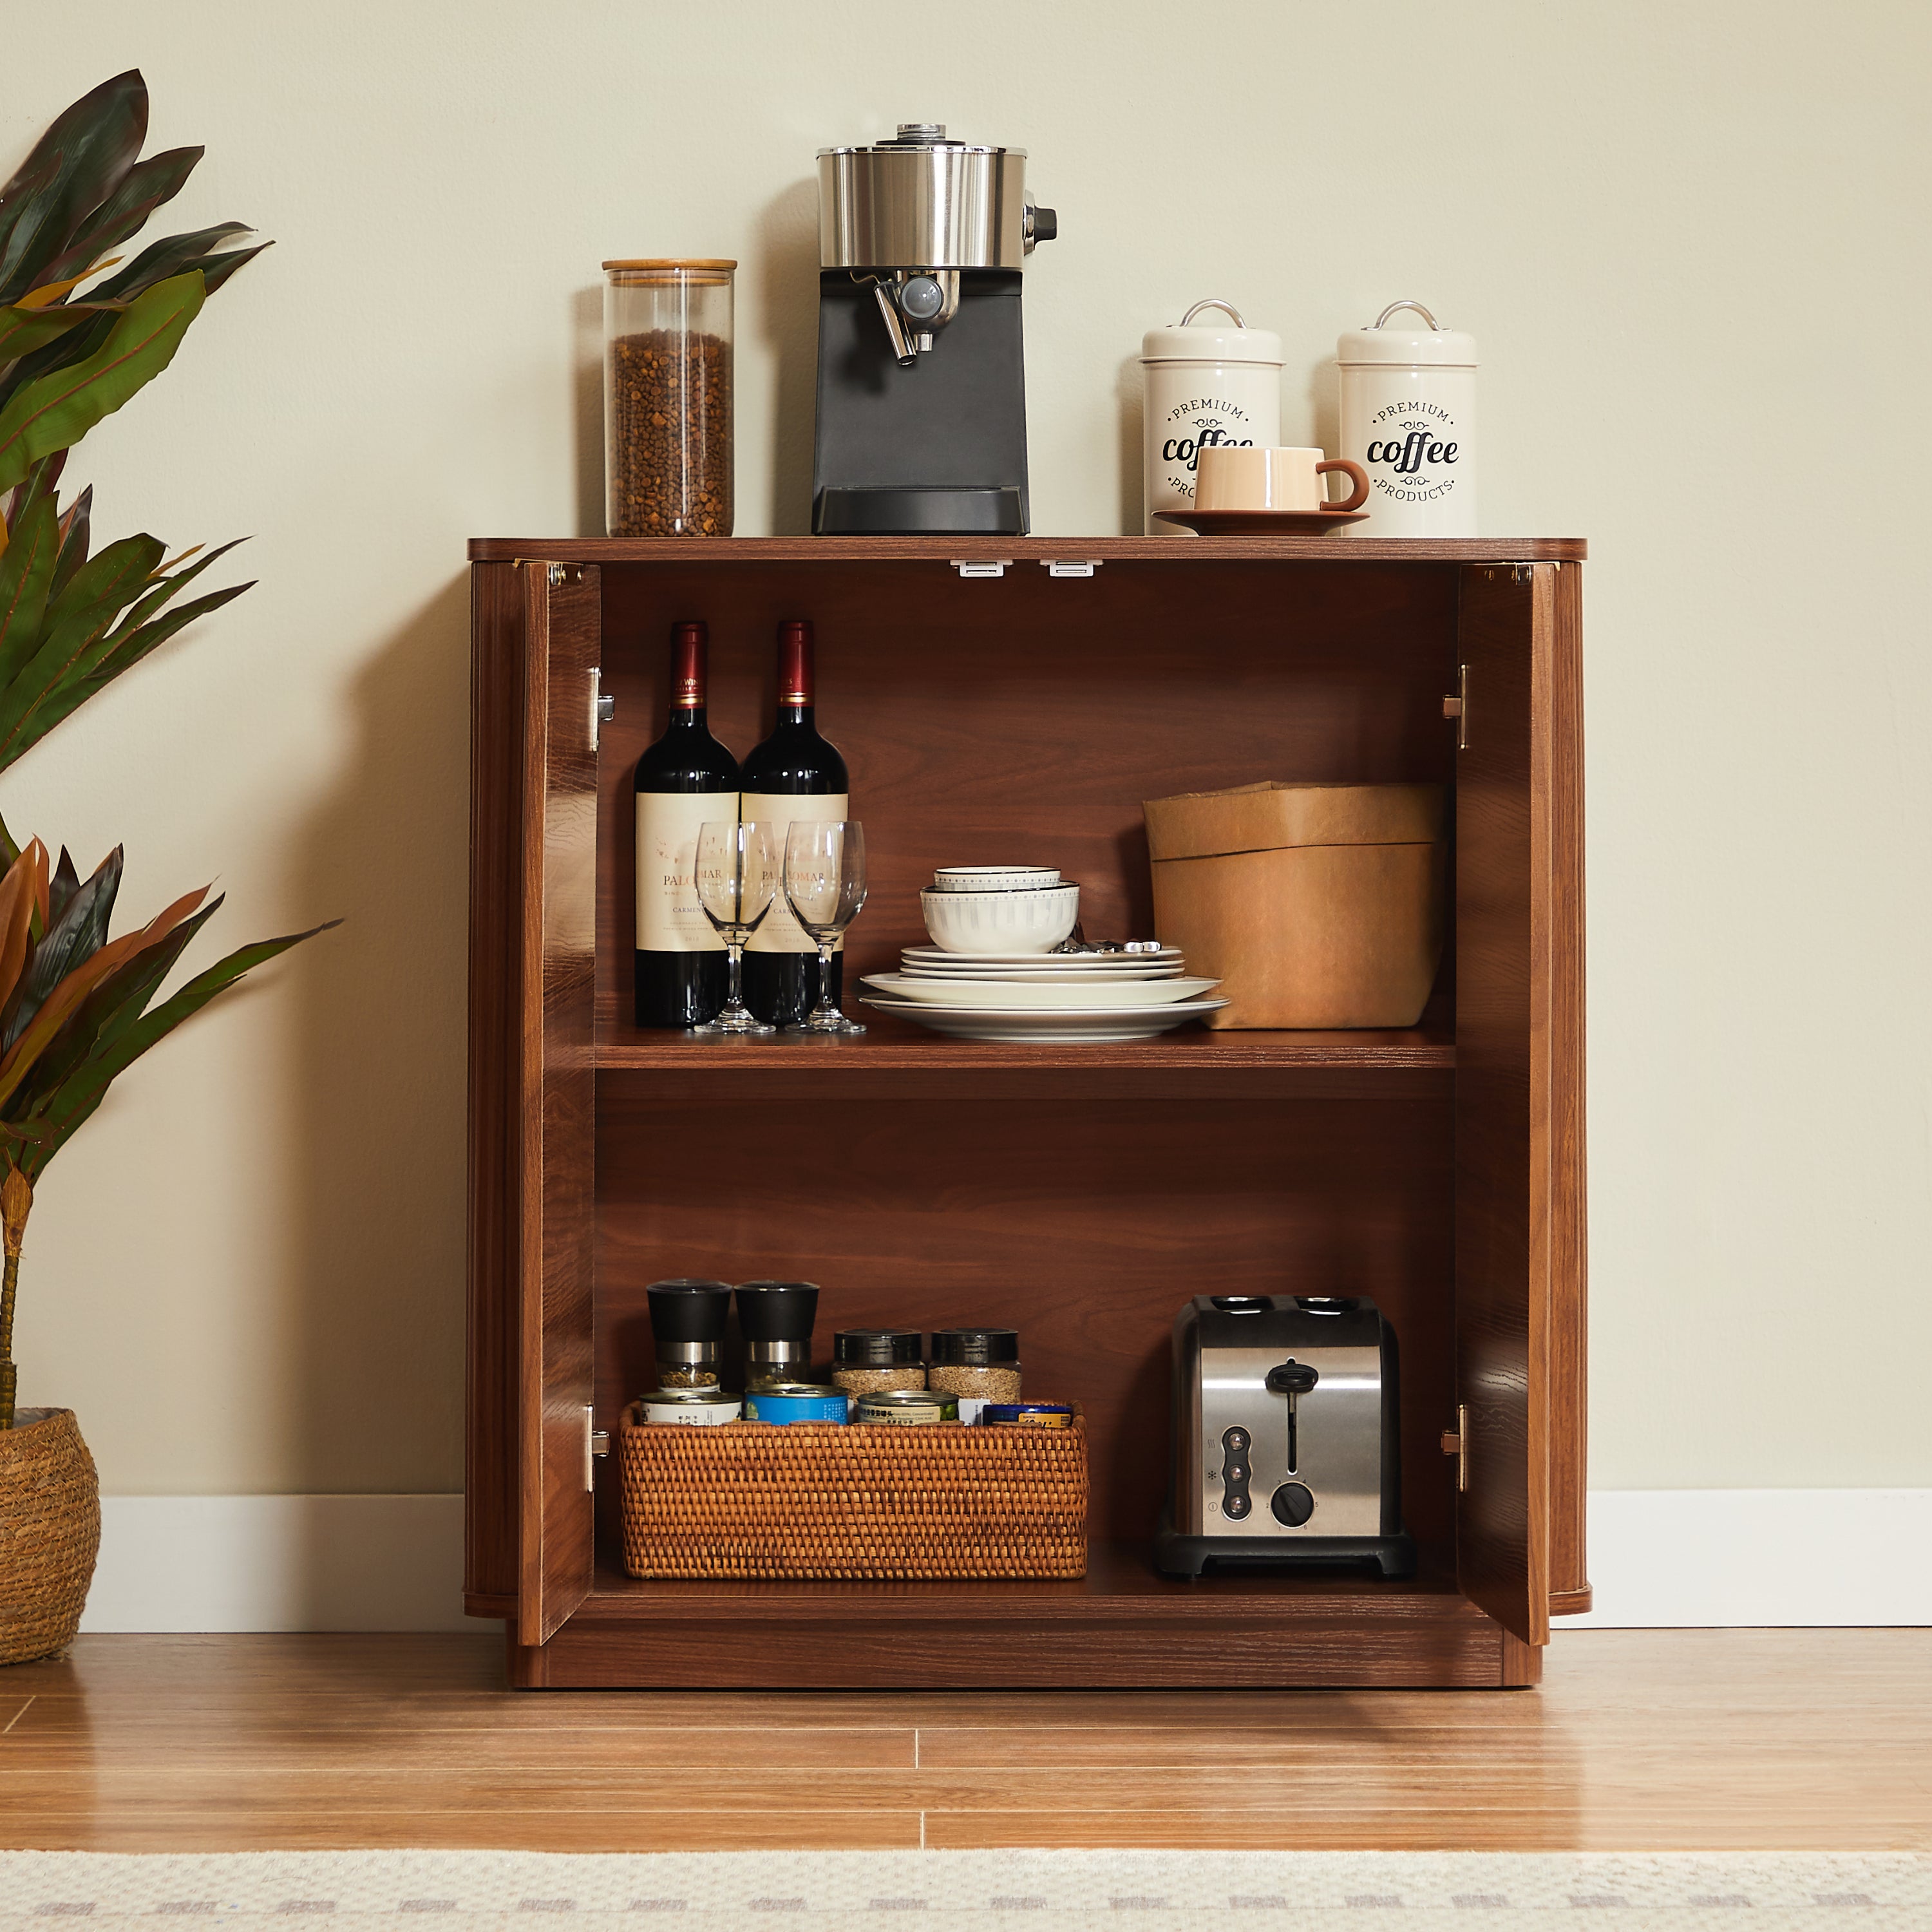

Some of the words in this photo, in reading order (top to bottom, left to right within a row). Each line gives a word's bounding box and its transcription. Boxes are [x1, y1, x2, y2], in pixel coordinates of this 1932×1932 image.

[1172, 399, 1244, 419] PREMIUM
[1377, 401, 1449, 422] PREMIUM
[1367, 431, 1459, 473] coffee
[1376, 479, 1453, 502] PRODUCTS
